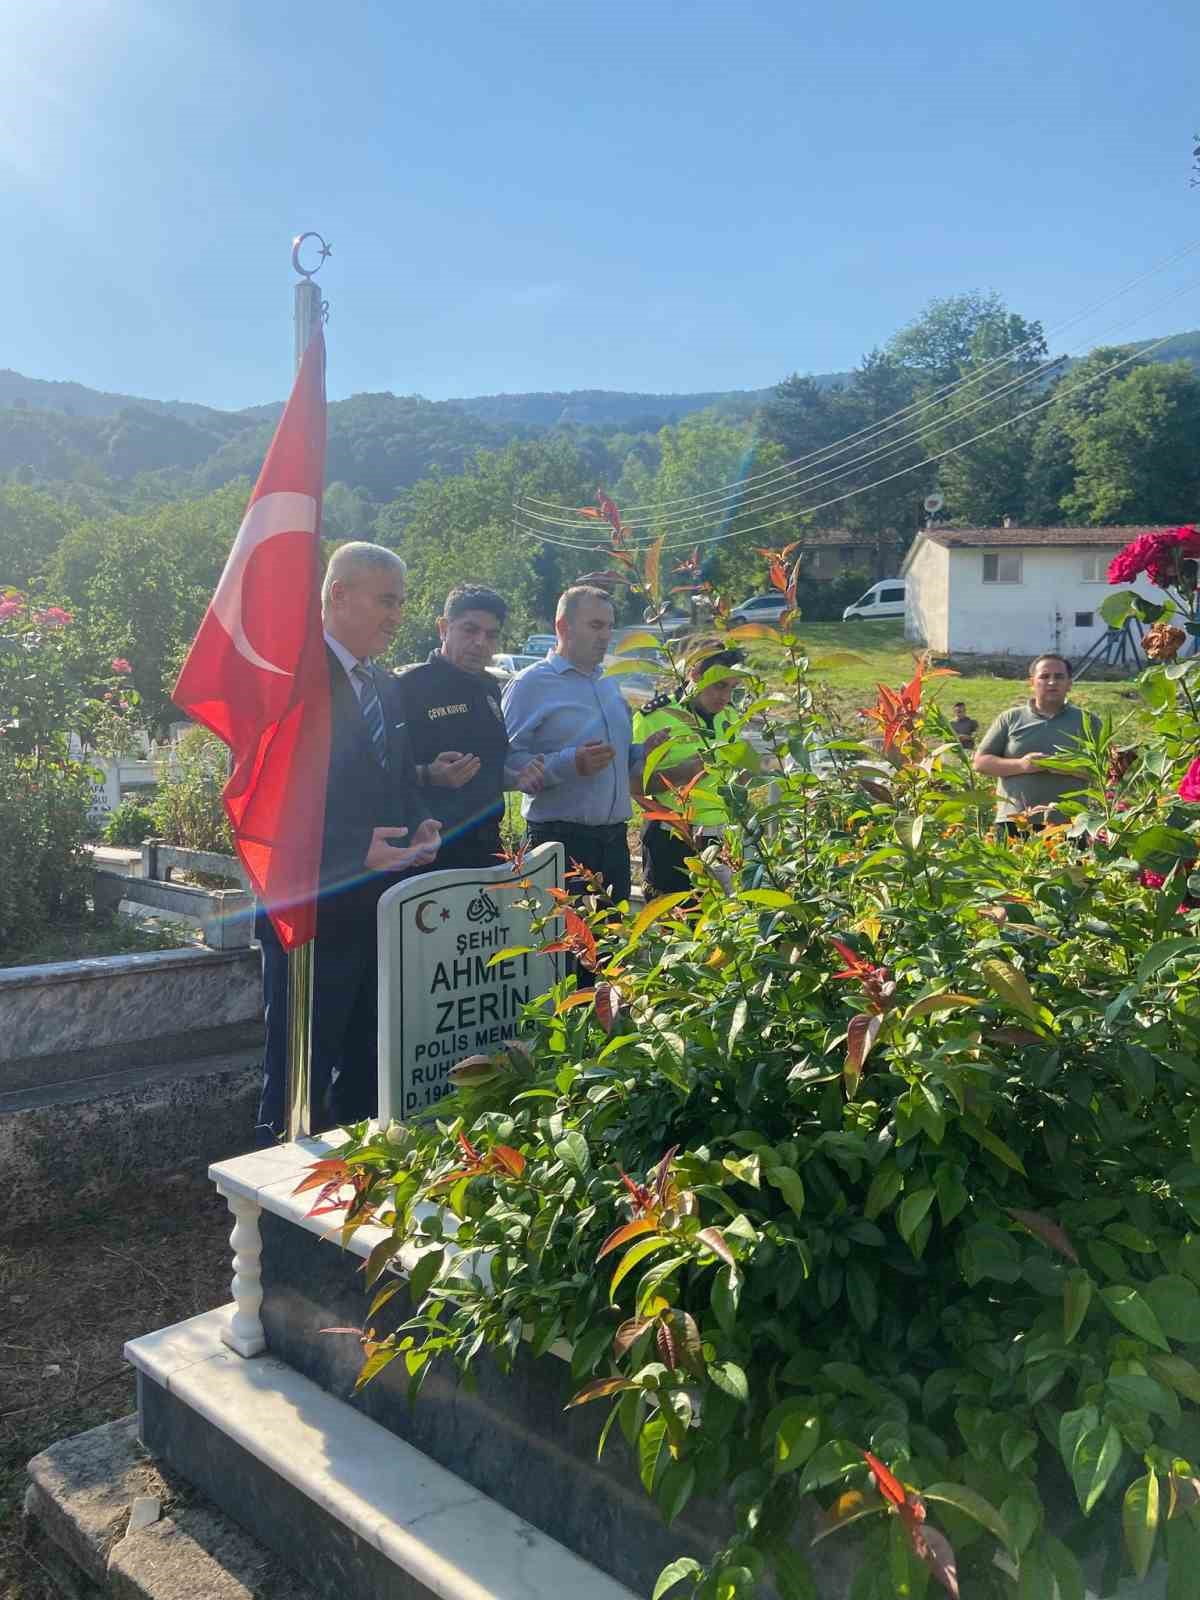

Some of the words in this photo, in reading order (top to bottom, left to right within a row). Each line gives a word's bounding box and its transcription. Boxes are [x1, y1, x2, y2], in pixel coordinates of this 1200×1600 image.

[455, 925, 510, 955] ŞEHİT
[435, 984, 530, 1035] ZERİN
[415, 1034, 469, 1062] POLİS
[475, 1019, 538, 1047] MEMUR
